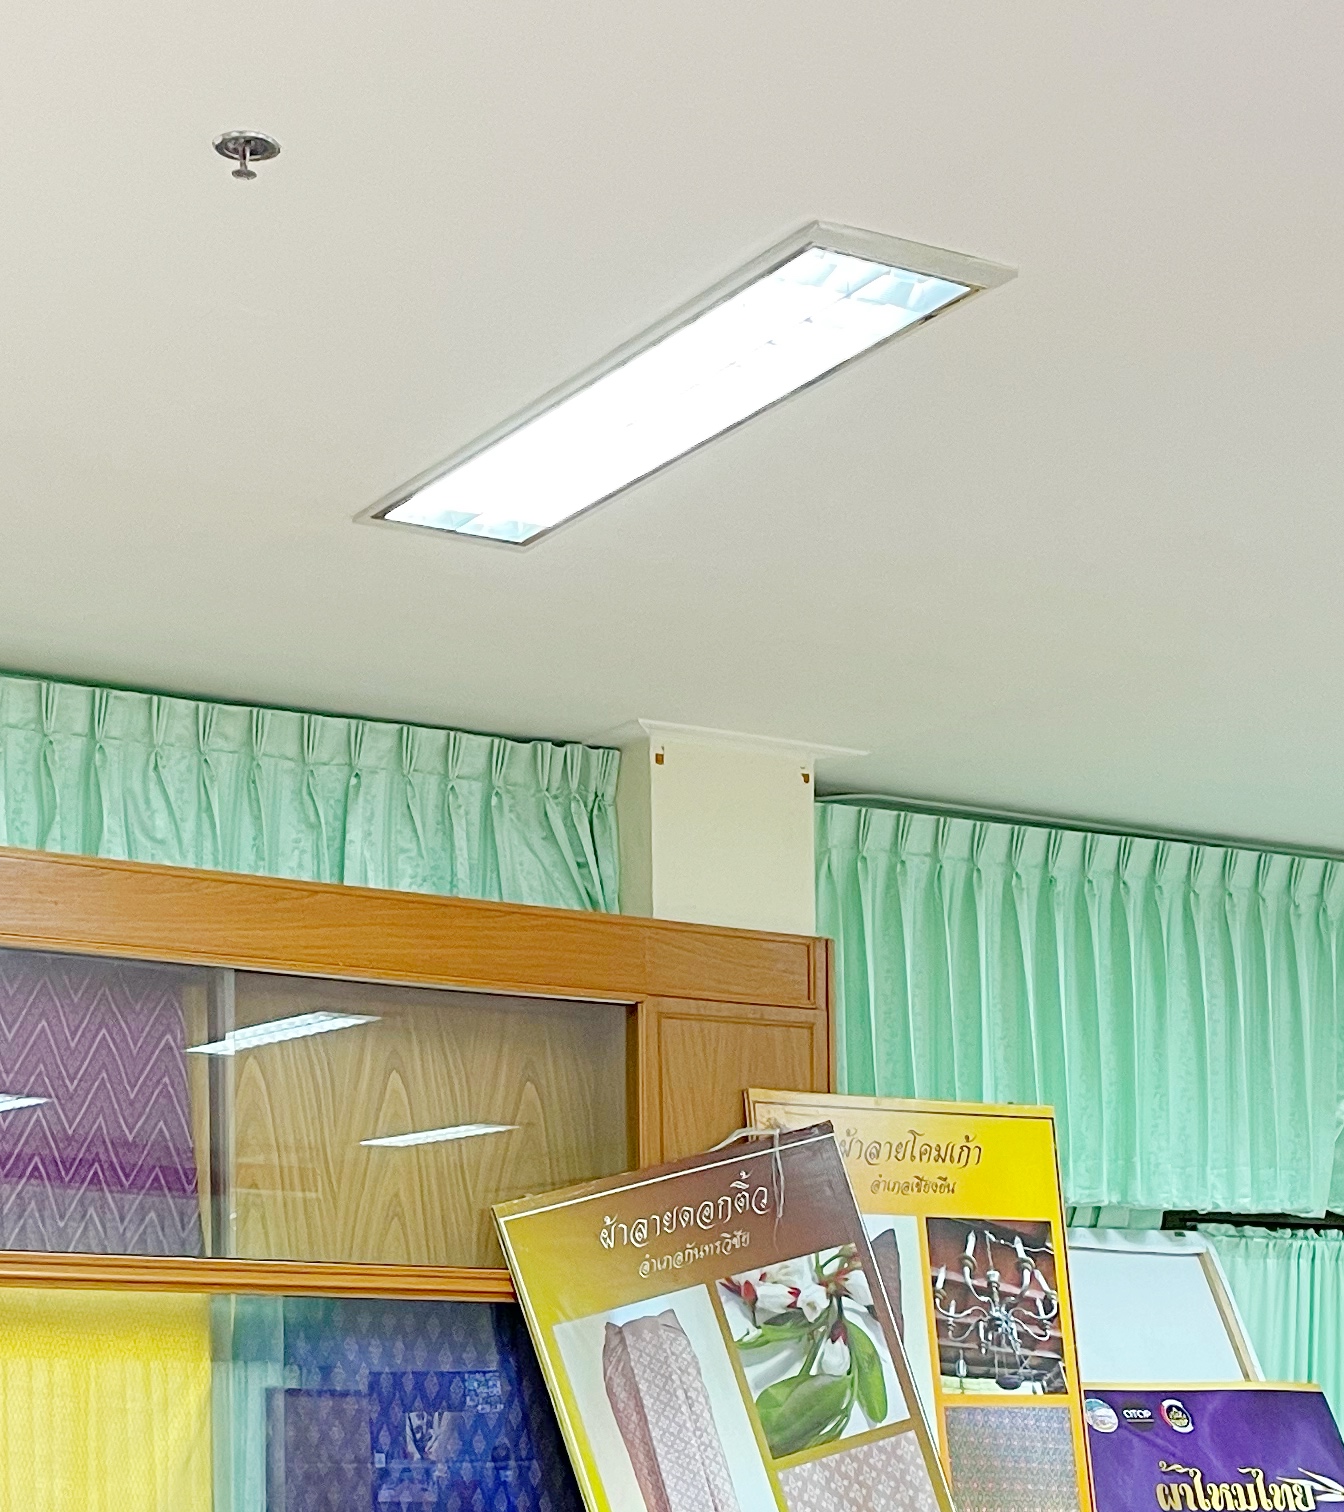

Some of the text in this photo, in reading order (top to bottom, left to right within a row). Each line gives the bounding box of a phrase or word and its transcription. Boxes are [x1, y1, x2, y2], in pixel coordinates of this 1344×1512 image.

[599, 1170, 770, 1251] ผ้าลายดอกติ้ว
[638, 1229, 751, 1279] อำเภอกันทรวิชัย
[1156, 1460, 1317, 1512] ผ้าไหมไทย
